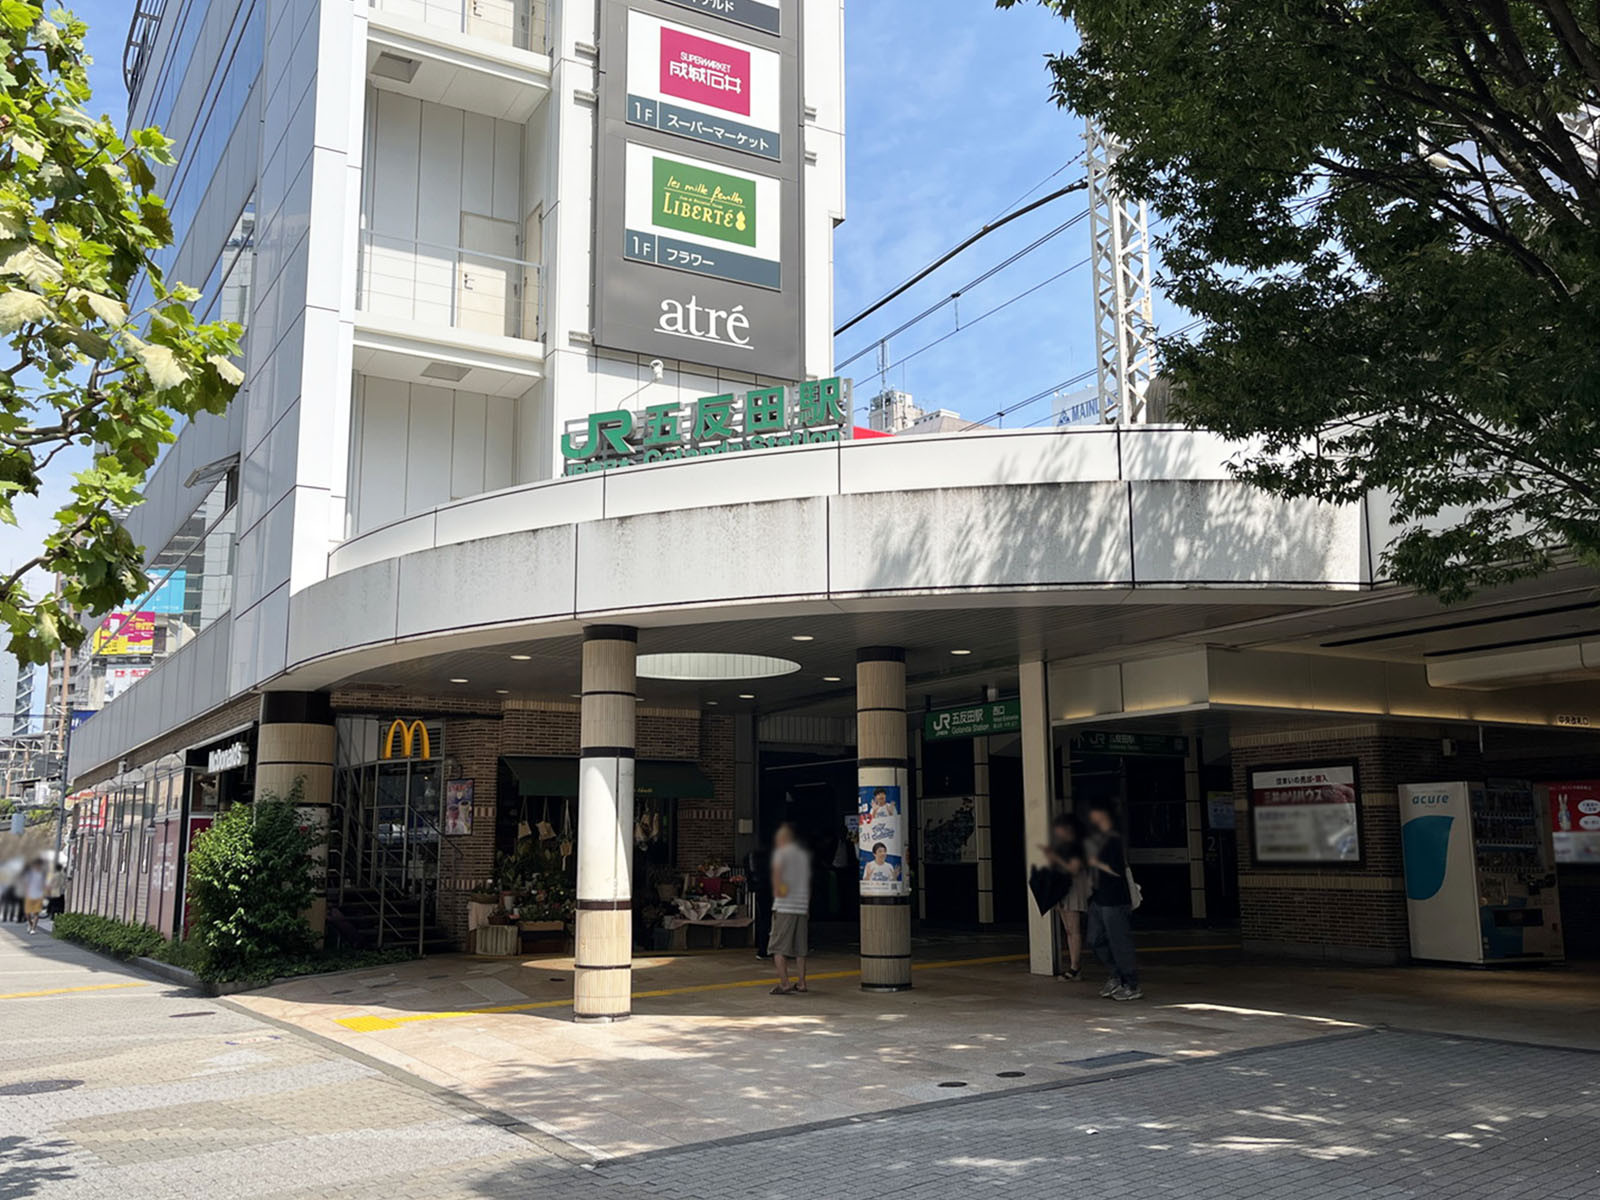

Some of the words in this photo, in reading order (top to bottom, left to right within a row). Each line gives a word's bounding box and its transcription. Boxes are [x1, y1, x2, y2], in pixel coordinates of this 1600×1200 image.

[680, 51, 731, 73] SUPERMARKET
[669, 60, 742, 94] 成城石井
[667, 114, 769, 151] スーパーマーケット
[666, 248, 715, 265] フラワー
[659, 295, 751, 346] atré
[1411, 794, 1449, 805] acure
